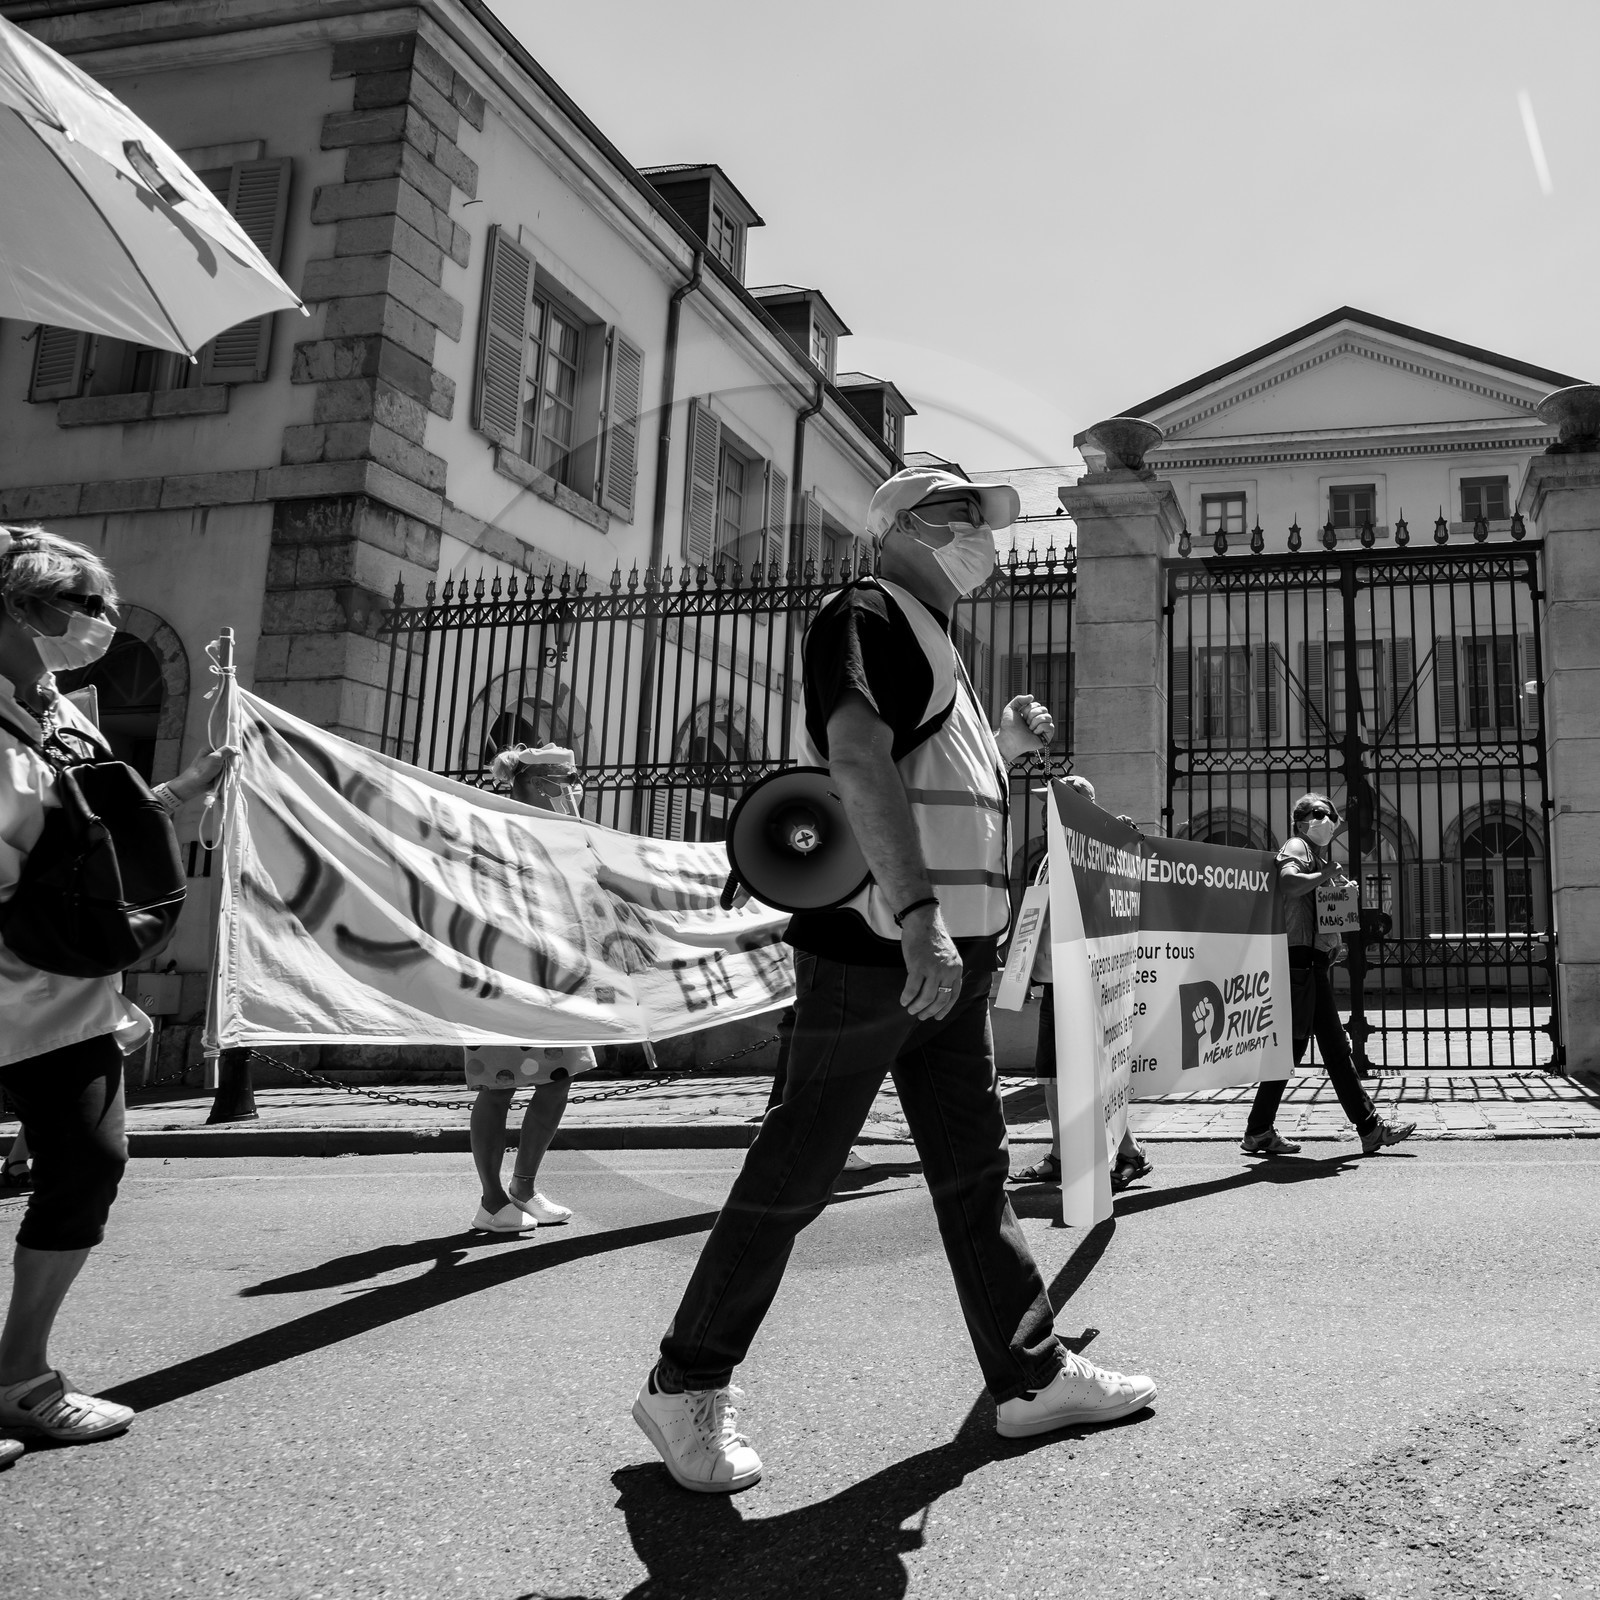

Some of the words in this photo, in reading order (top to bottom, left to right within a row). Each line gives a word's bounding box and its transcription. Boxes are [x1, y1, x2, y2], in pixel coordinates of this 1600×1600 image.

[1087, 837, 1116, 875] SERVICES
[1140, 853, 1269, 892] MÉDICO-SOCIAUX
[1327, 903, 1336, 912] AU
[1136, 945, 1161, 960] our
[1166, 942, 1195, 960] tous
[671, 951, 738, 1013] EN
[1135, 969, 1157, 984] ces
[1132, 1001, 1147, 1017] ce
[1235, 1035, 1269, 1057] COMBAT
[1130, 1055, 1158, 1074] aire
